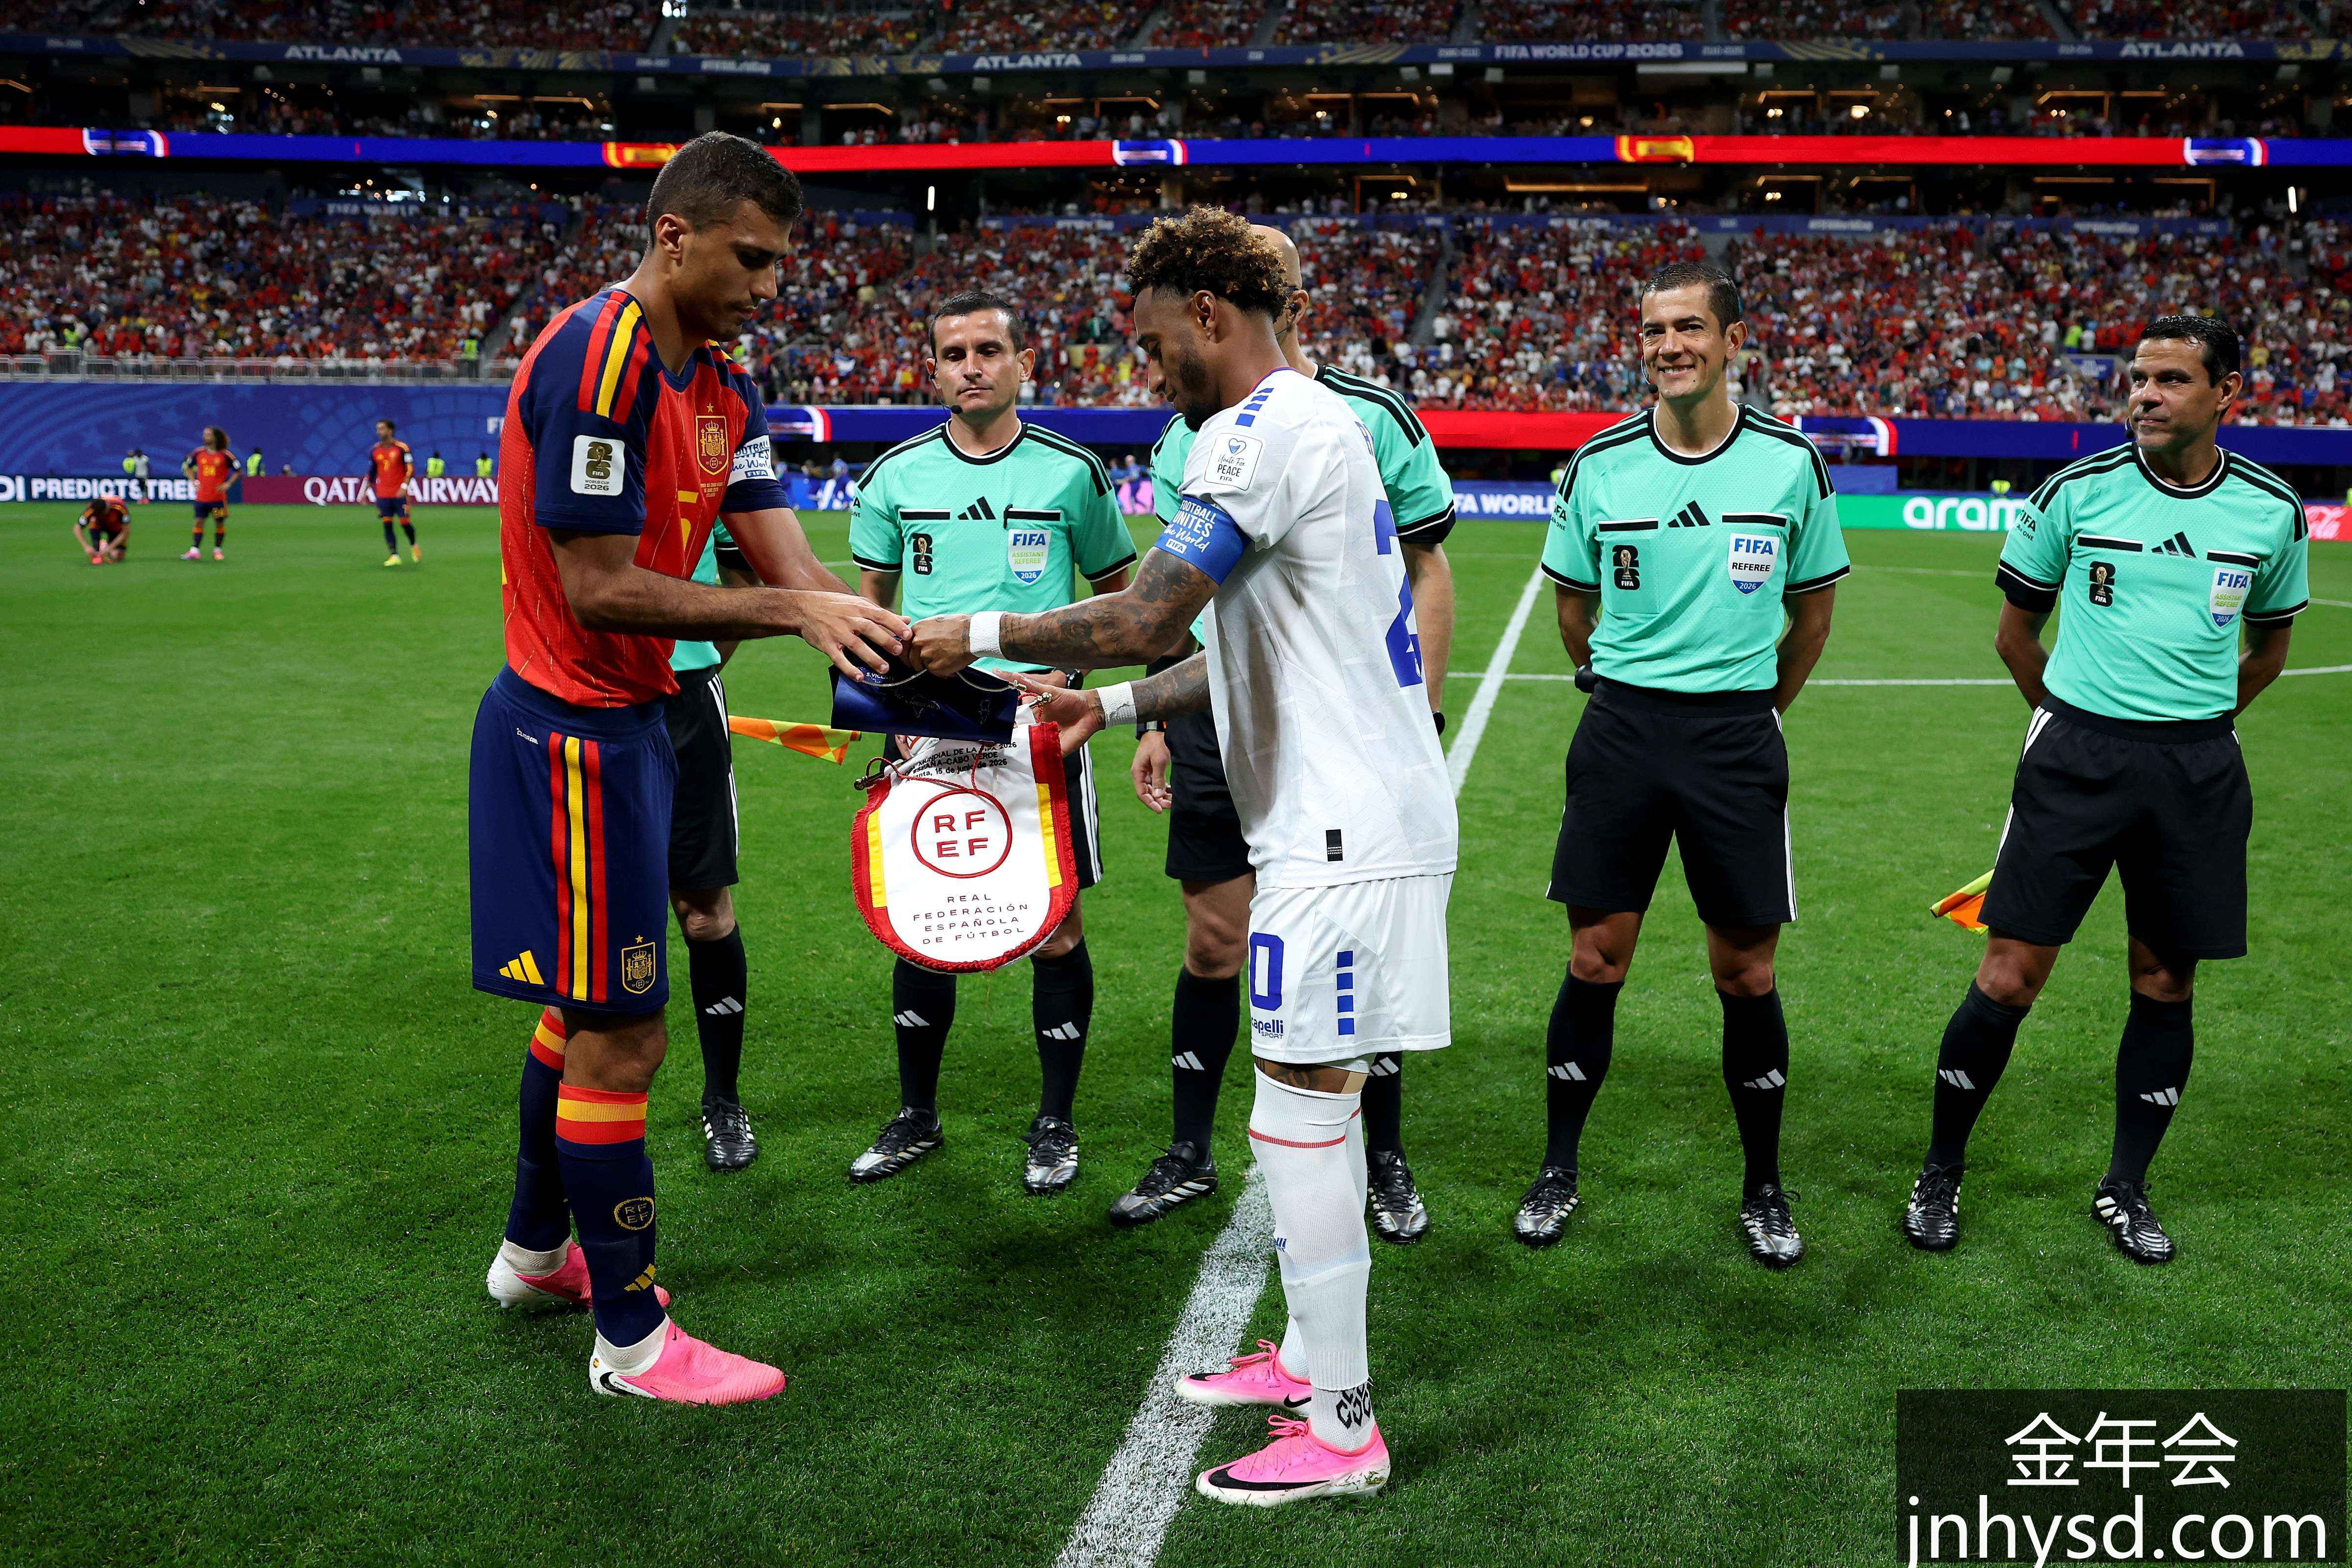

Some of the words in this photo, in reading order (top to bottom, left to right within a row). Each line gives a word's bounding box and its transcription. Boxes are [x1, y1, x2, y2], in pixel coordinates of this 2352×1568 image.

[285, 45, 402, 62] ATLANTA
[1494, 45, 1530, 59] FIFA
[1531, 45, 1590, 58] WORLD
[1591, 45, 1624, 58] CUP
[1626, 44, 1683, 58] 2026
[2119, 42, 2244, 57] ATLANTA
[973, 54, 1082, 70] ATLANTA
[1217, 464, 1242, 477] PEACE
[304, 477, 377, 506] QATA
[408, 477, 499, 503] AIRWAY
[1180, 500, 1217, 524] FOOTBALL
[1903, 496, 2025, 531] aram
[1173, 510, 1213, 538] UNITES
[1012, 533, 1046, 546] FIFA
[1164, 524, 1176, 535] the
[1176, 527, 1210, 553] World
[1168, 541, 1184, 552] FIFA
[1734, 538, 1774, 555] FIFA
[1732, 562, 1771, 572] REFEREE
[2217, 572, 2249, 588] FIFA
[918, 750, 951, 766] MUNDIAL
[989, 758, 1008, 767] 2026
[947, 893, 991, 903] REAL
[913, 903, 1028, 921] FEDERACIÓN
[925, 917, 1019, 931] ESPAÑOLA
[955, 928, 1024, 941] FÚTBOL
